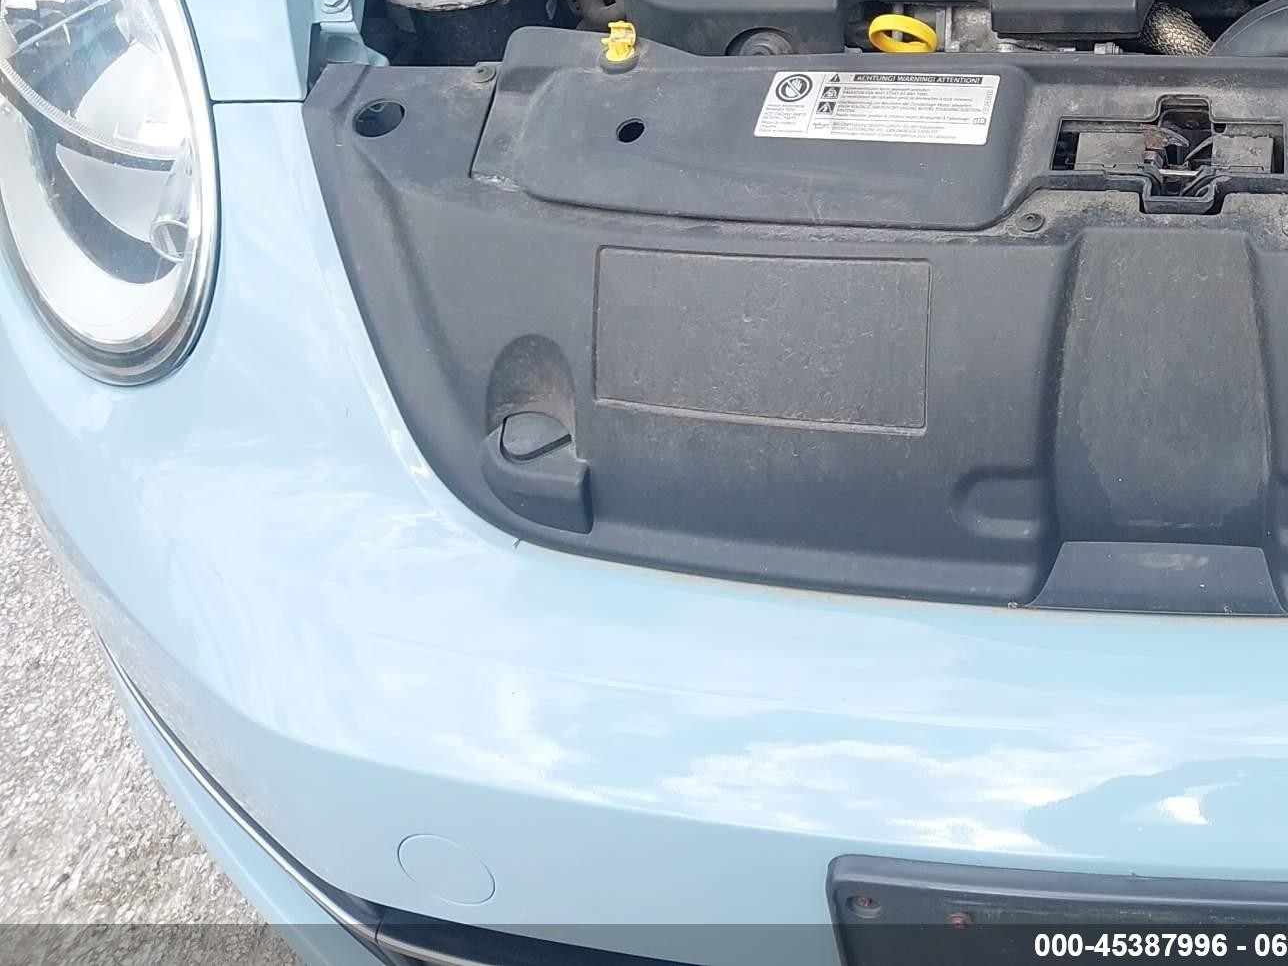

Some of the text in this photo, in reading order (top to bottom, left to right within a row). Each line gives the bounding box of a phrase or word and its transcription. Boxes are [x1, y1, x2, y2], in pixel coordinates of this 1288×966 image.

[856, 74, 981, 84] ACHTUNG! WARNING! ATTENTION!
